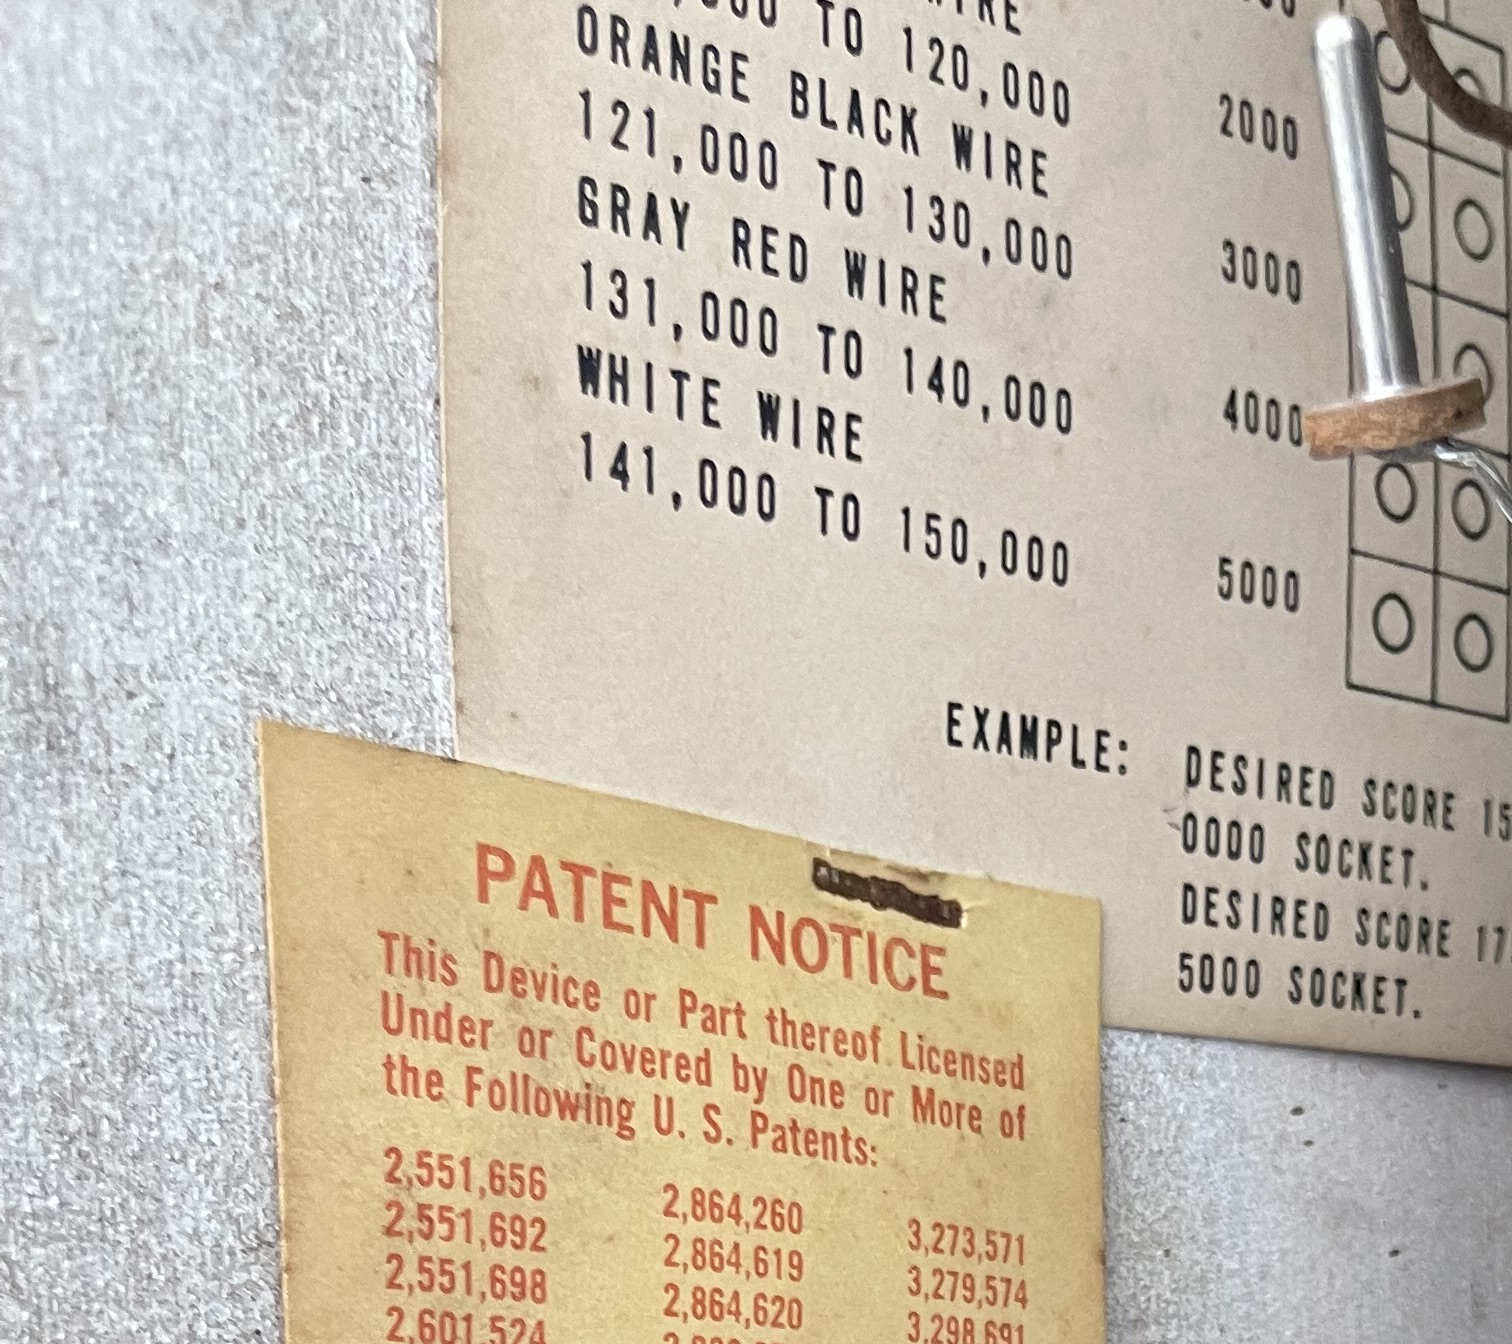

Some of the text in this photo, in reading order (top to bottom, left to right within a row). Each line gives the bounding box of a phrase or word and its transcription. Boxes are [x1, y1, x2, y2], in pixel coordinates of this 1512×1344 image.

[577, 3, 1048, 198] ORANGE BLACK WIRE
[816, 0, 863, 57] TO
[903, 24, 1070, 127] 120,000
[1219, 93, 1298, 160] 2000
[579, 88, 1072, 280] 121,000 TO 130,000
[578, 176, 947, 325] GRAY RED WIRE
[1221, 238, 1302, 305] 3000
[581, 259, 1072, 435] 131,000 TO 140,000
[576, 343, 862, 464] WHITE WIRE
[1223, 387, 1303, 447] 4000
[580, 431, 1068, 587] 141,000 TO 150,000
[1218, 556, 1299, 613] 5000
[947, 701, 1128, 776] EXAMPLE:
[1184, 745, 1335, 810] DESIRED
[1362, 777, 1455, 831] SCORE
[1180, 811, 1428, 891] 0000 SOCKET.
[476, 842, 949, 1000] PATENT NOTICE
[1182, 882, 1330, 941] DESIRED
[1355, 907, 1451, 958] SCORE
[377, 930, 1024, 1091] This Device or Part thereof Licensed
[1178, 951, 1421, 1019] 5000 SOCKET.
[381, 991, 1026, 1141] Under or Covered by One or More of
[382, 1054, 877, 1166] the Following U. S. Patents:
[384, 1147, 546, 1201] 2,551,656
[386, 1253, 547, 1304] 2,551,698
[664, 1233, 803, 1282] 2,864,619
[908, 1218, 1024, 1265] 3,273,571
